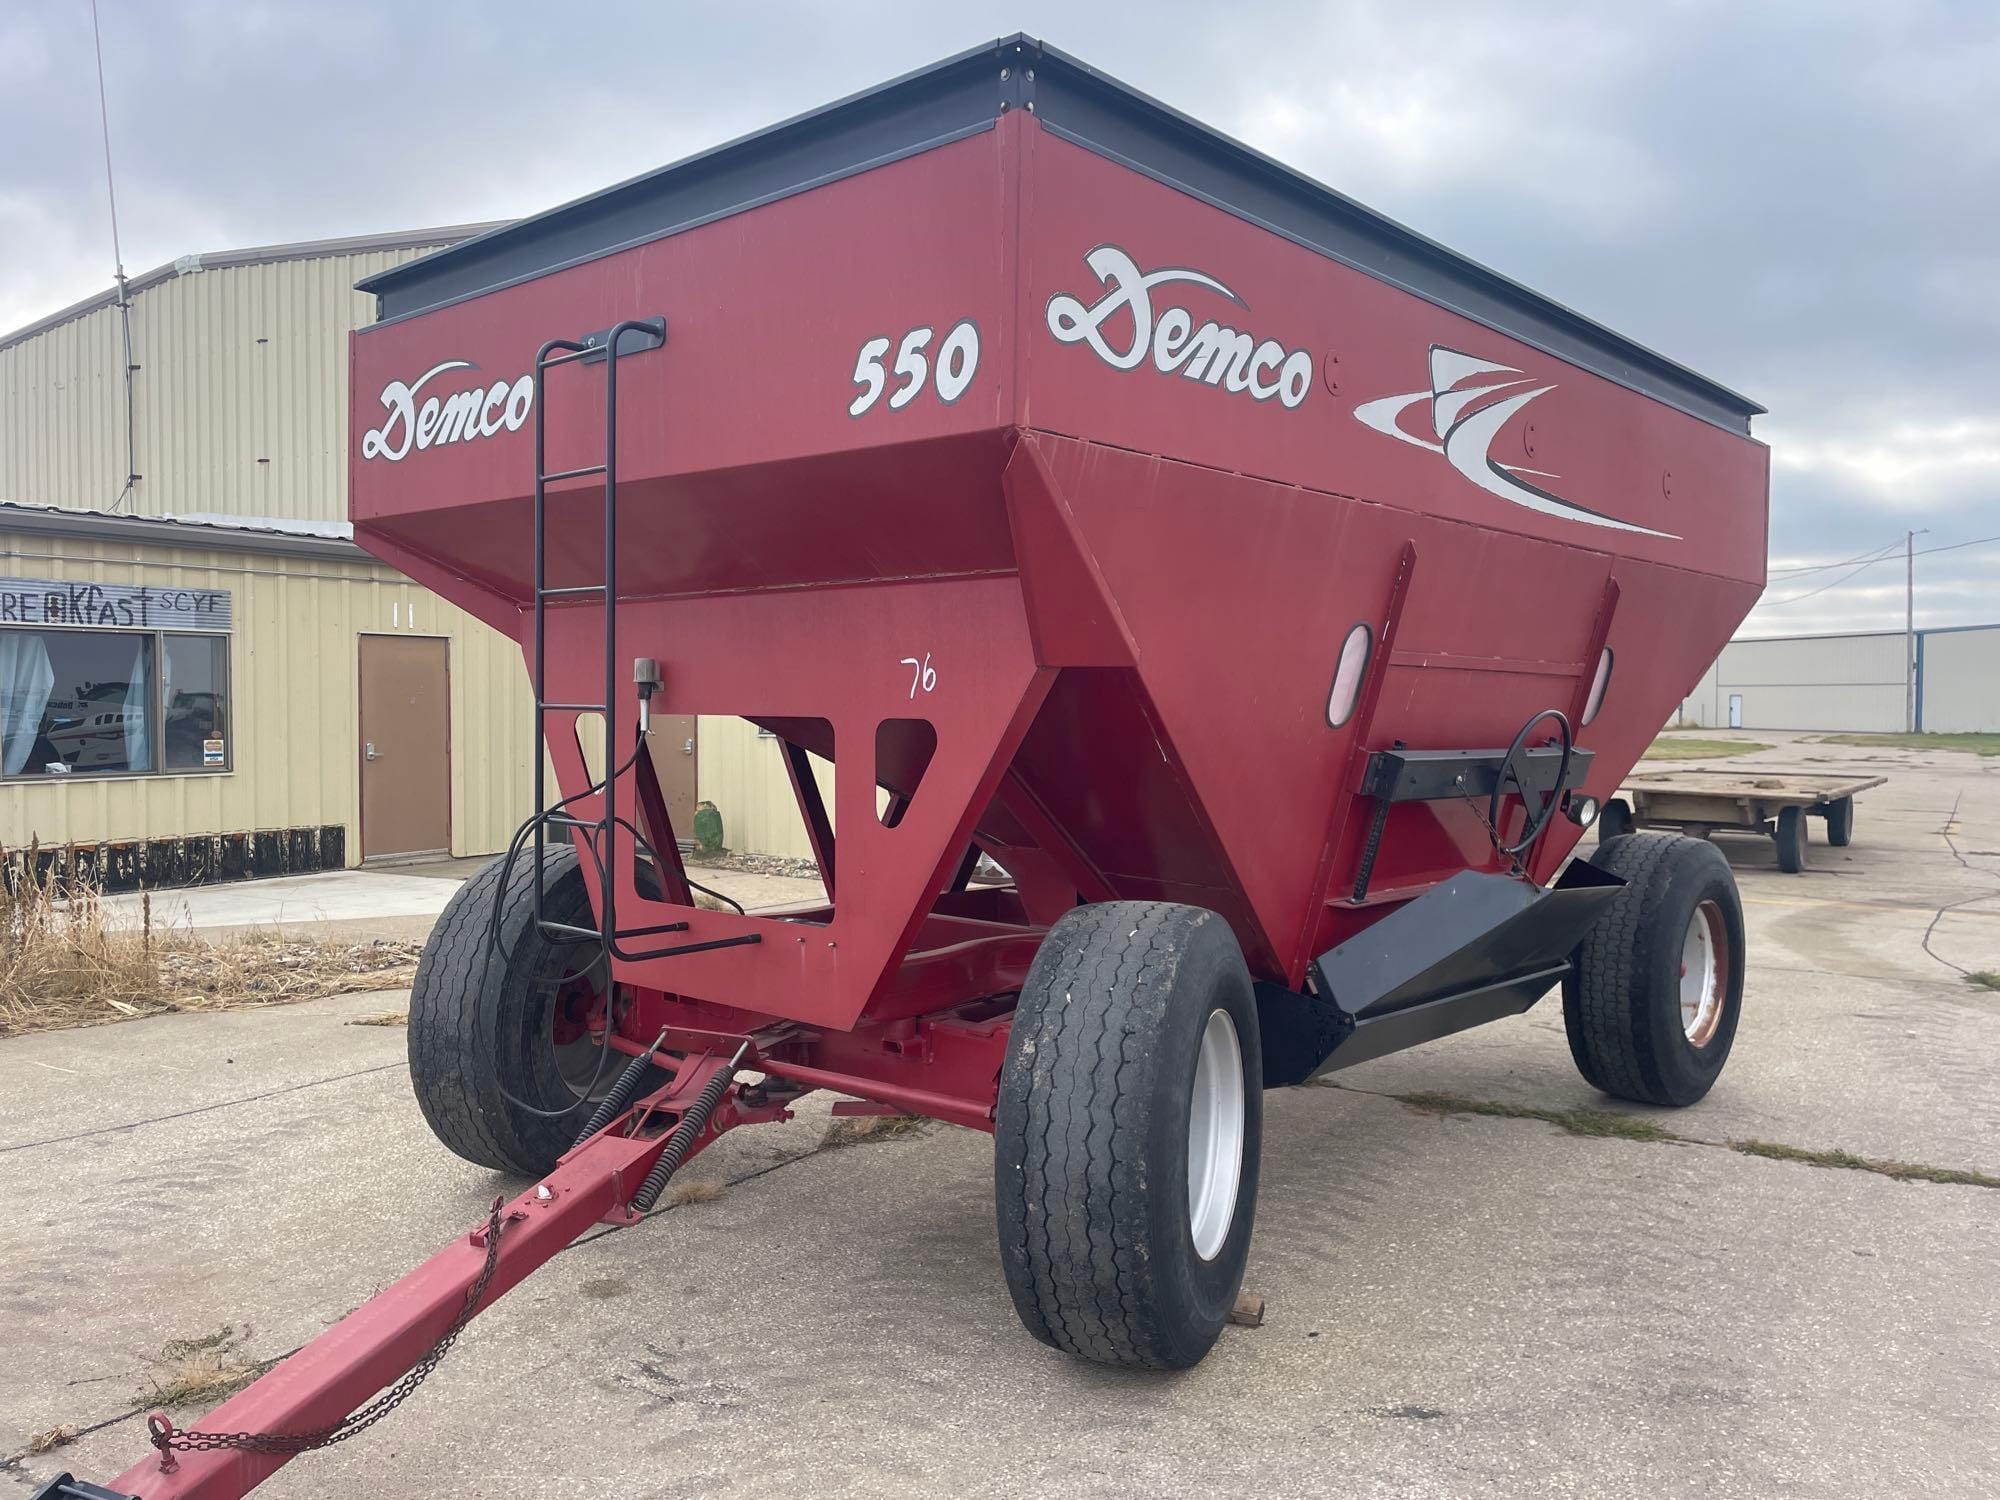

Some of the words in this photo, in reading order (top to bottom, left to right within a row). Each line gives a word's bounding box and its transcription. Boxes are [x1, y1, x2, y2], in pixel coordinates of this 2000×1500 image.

[849, 318, 980, 418] 550
[1046, 244, 1312, 409] Demco
[362, 360, 535, 462] Demco
[901, 651, 936, 699] 76
